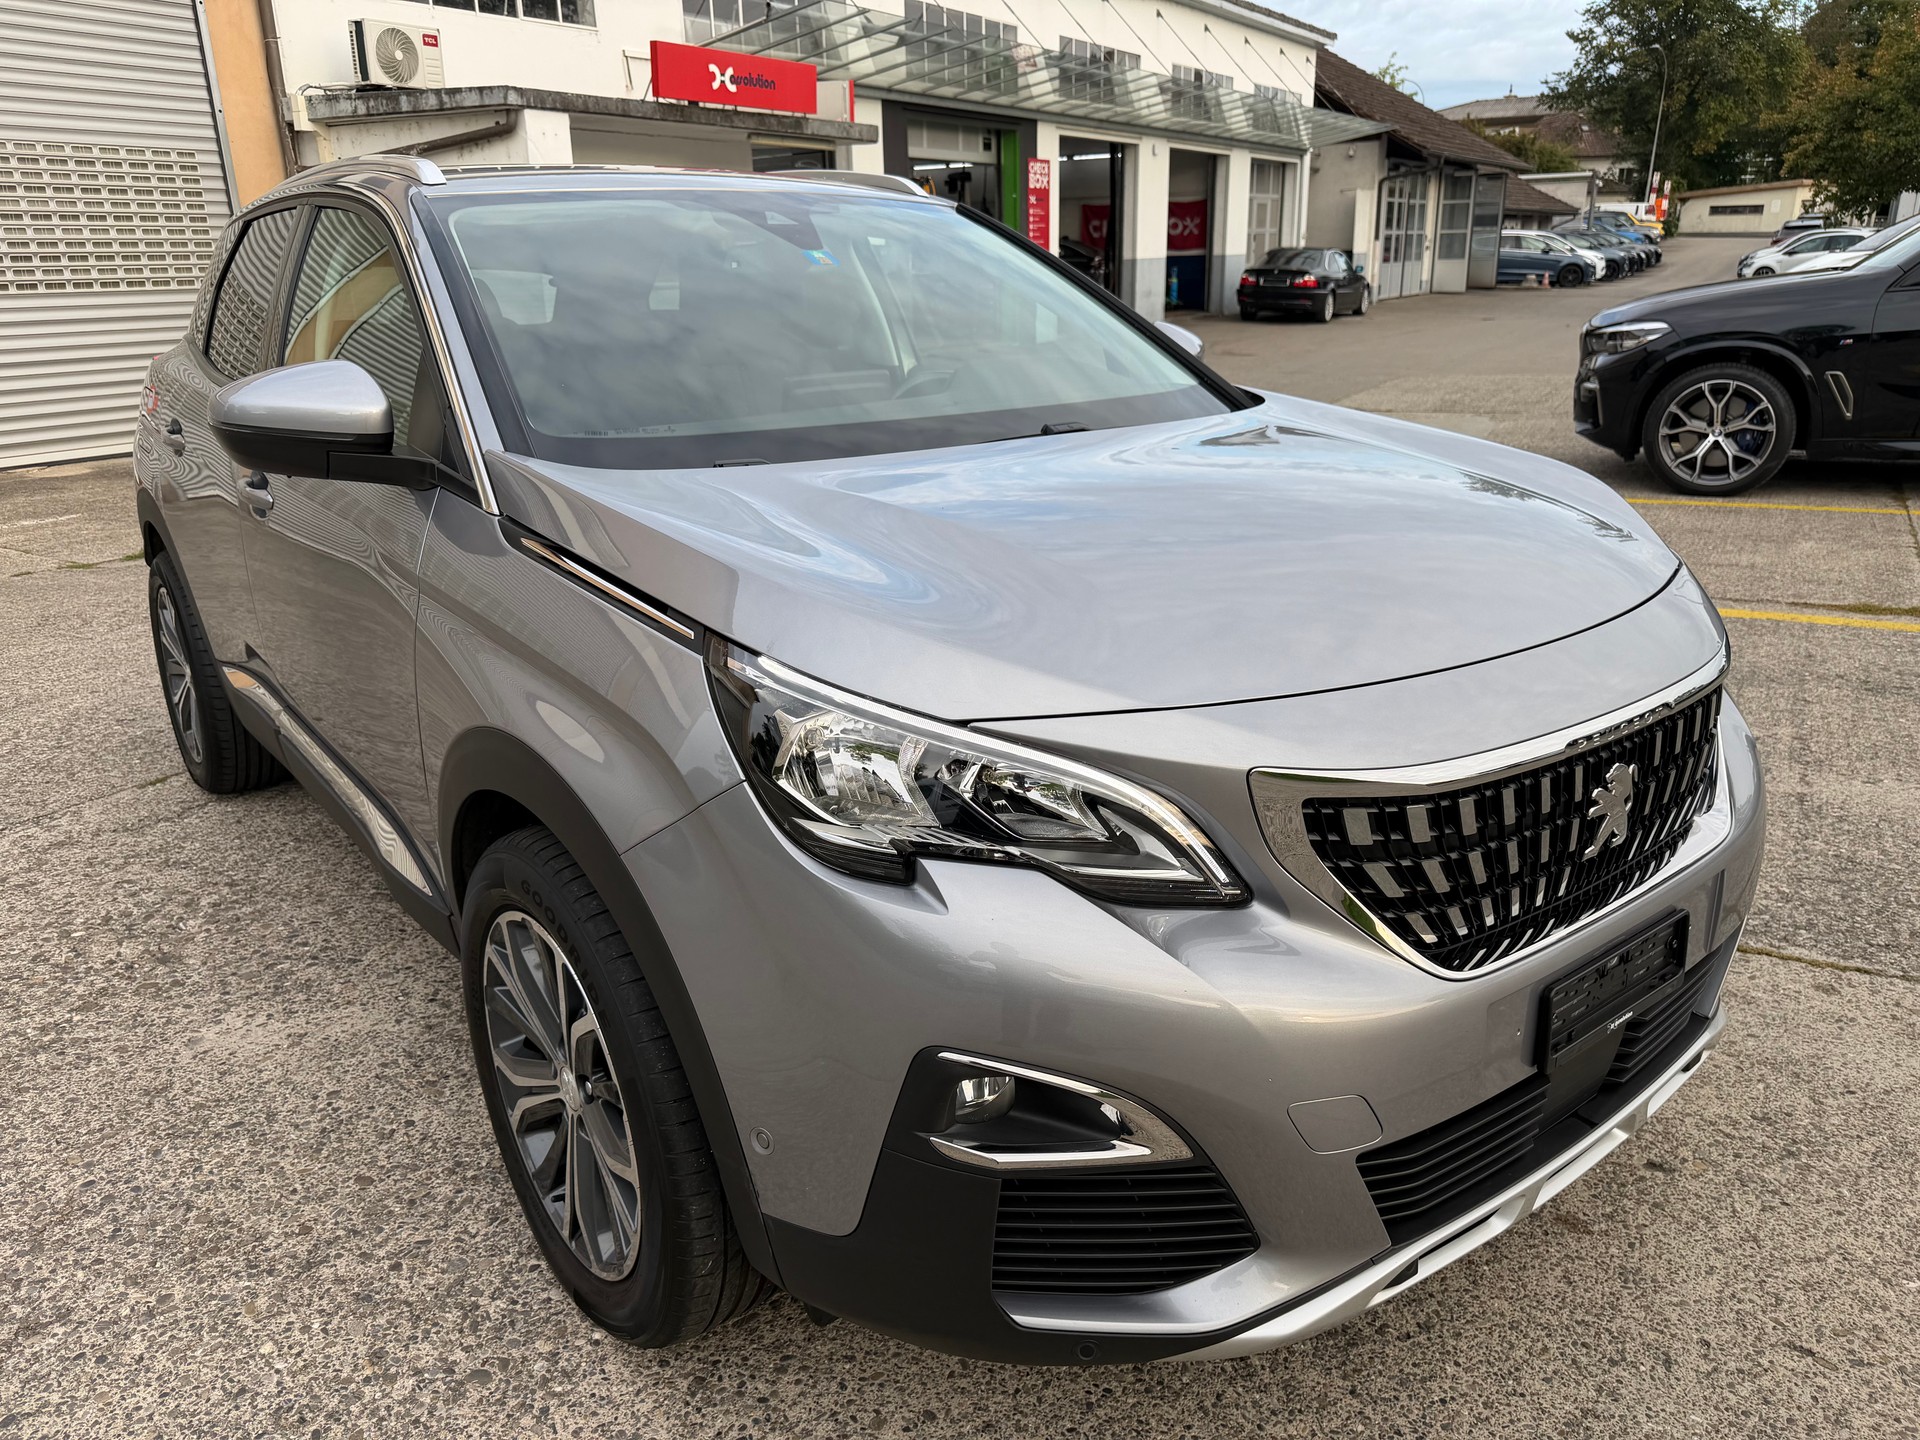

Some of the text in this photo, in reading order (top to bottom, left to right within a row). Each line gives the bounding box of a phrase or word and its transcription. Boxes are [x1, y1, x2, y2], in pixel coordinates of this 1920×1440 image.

[423, 37, 437, 45] TCL
[1029, 173, 1049, 189] BOX
[1168, 217, 1200, 236] OX
[1577, 706, 1664, 752] PEUGEOT
[521, 879, 612, 1028] GOODRIDE
